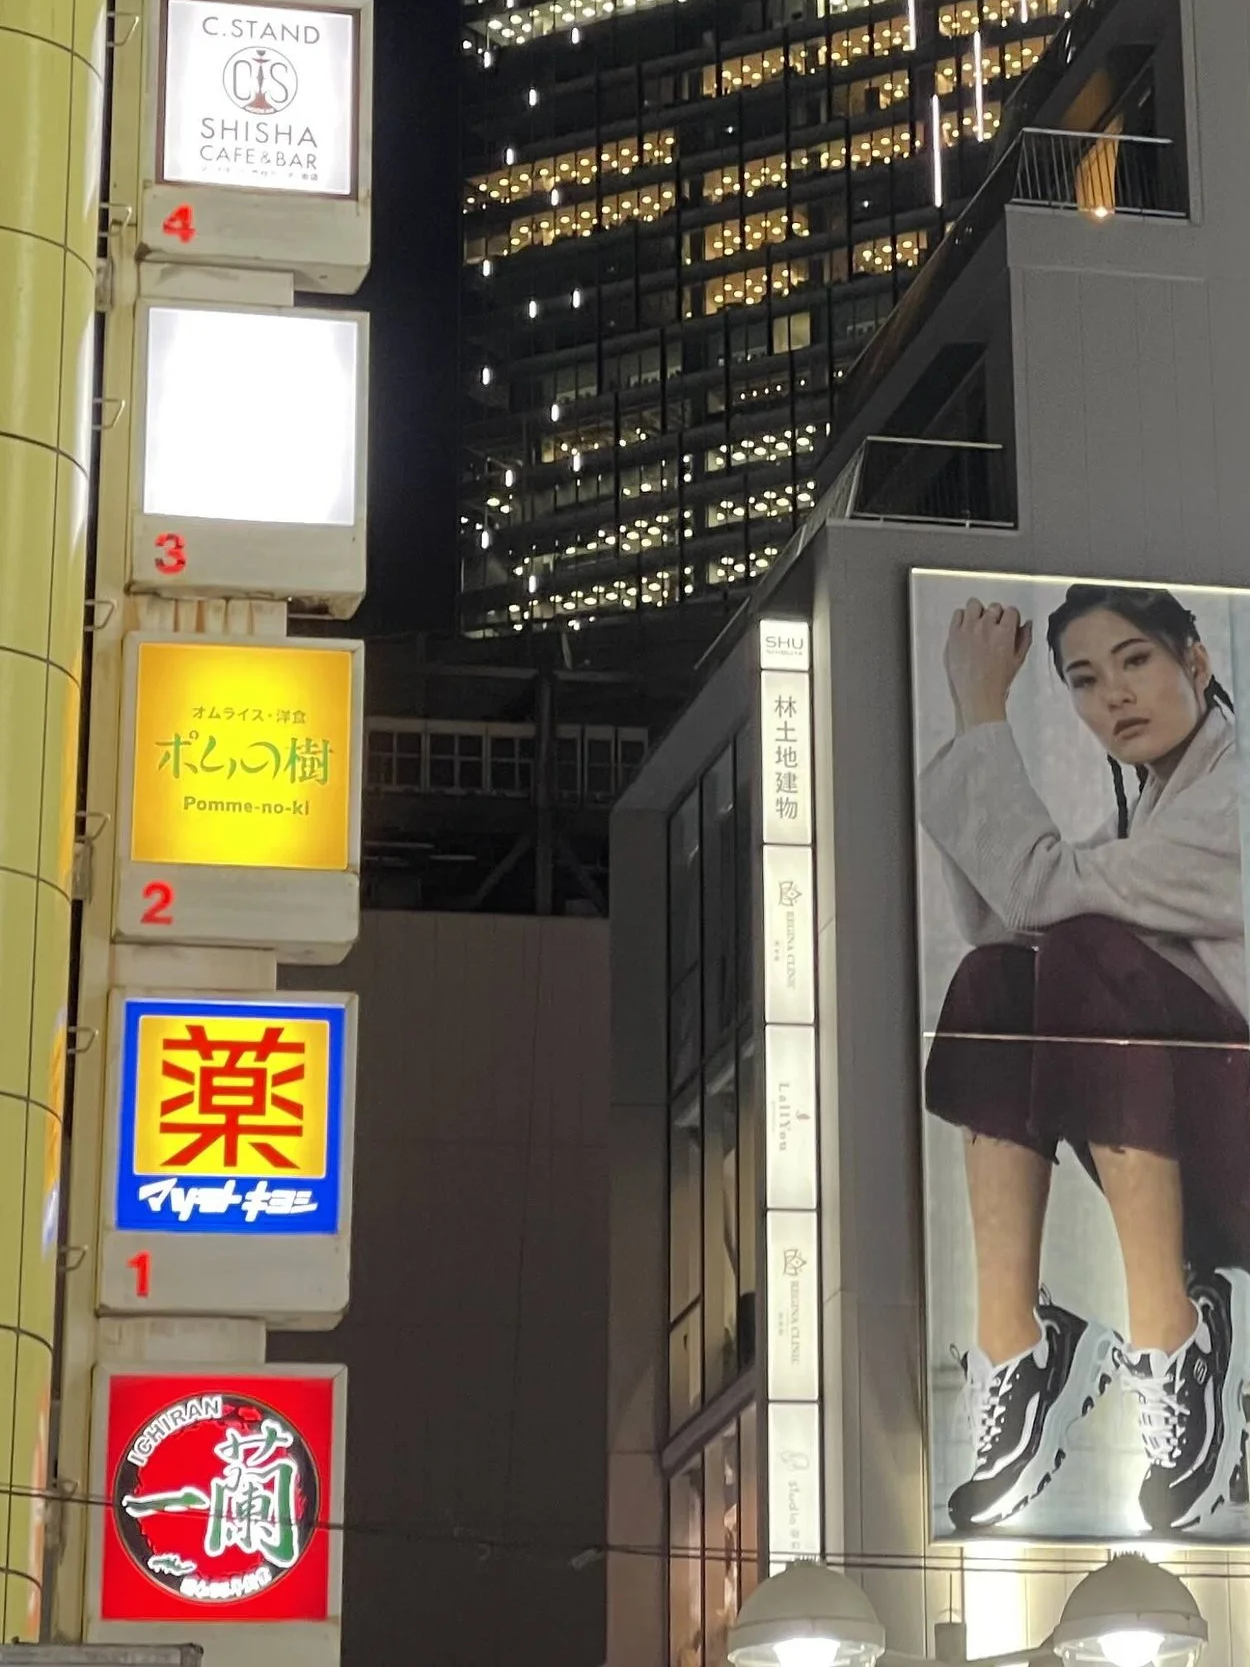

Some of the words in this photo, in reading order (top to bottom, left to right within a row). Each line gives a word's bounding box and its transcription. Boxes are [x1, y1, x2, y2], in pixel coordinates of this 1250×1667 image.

[202, 16, 320, 44] C.STAND
[201, 118, 318, 148] SHISHA
[163, 204, 194, 242] 4
[154, 533, 187, 574] 3
[764, 636, 804, 650] SHU
[192, 706, 307, 724] オムライス・洋食
[155, 730, 334, 785] ポムの樹
[774, 695, 798, 820] 林土地建物
[183, 796, 310, 815] Pomme-no-ki
[141, 881, 173, 925] 2
[160, 1025, 304, 1169] 薬
[127, 1252, 152, 1298] 1
[127, 1395, 223, 1466] ICHIRAN
[122, 1419, 298, 1566] 一蘭
